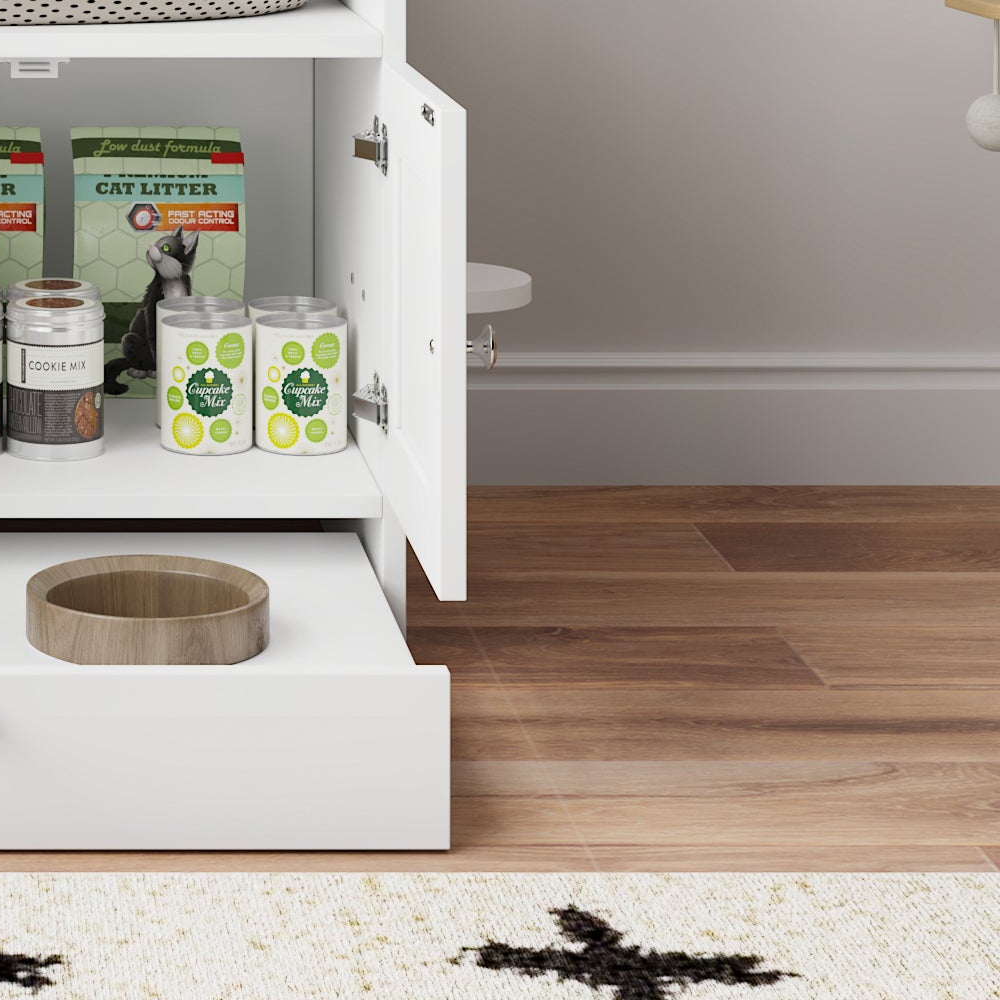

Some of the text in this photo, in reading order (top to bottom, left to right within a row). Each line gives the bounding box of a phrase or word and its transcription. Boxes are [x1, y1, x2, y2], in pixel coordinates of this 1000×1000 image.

[93, 139, 221, 158] Low dust formula
[95, 182, 217, 196] CAT LITTER
[168, 210, 235, 218] FAST ACTING
[28, 360, 87, 371] COOKIE MIX
[188, 382, 230, 397] Cupcake
[284, 382, 326, 397] Cupcake
[200, 395, 226, 407] Mix
[296, 395, 322, 407] Mix
